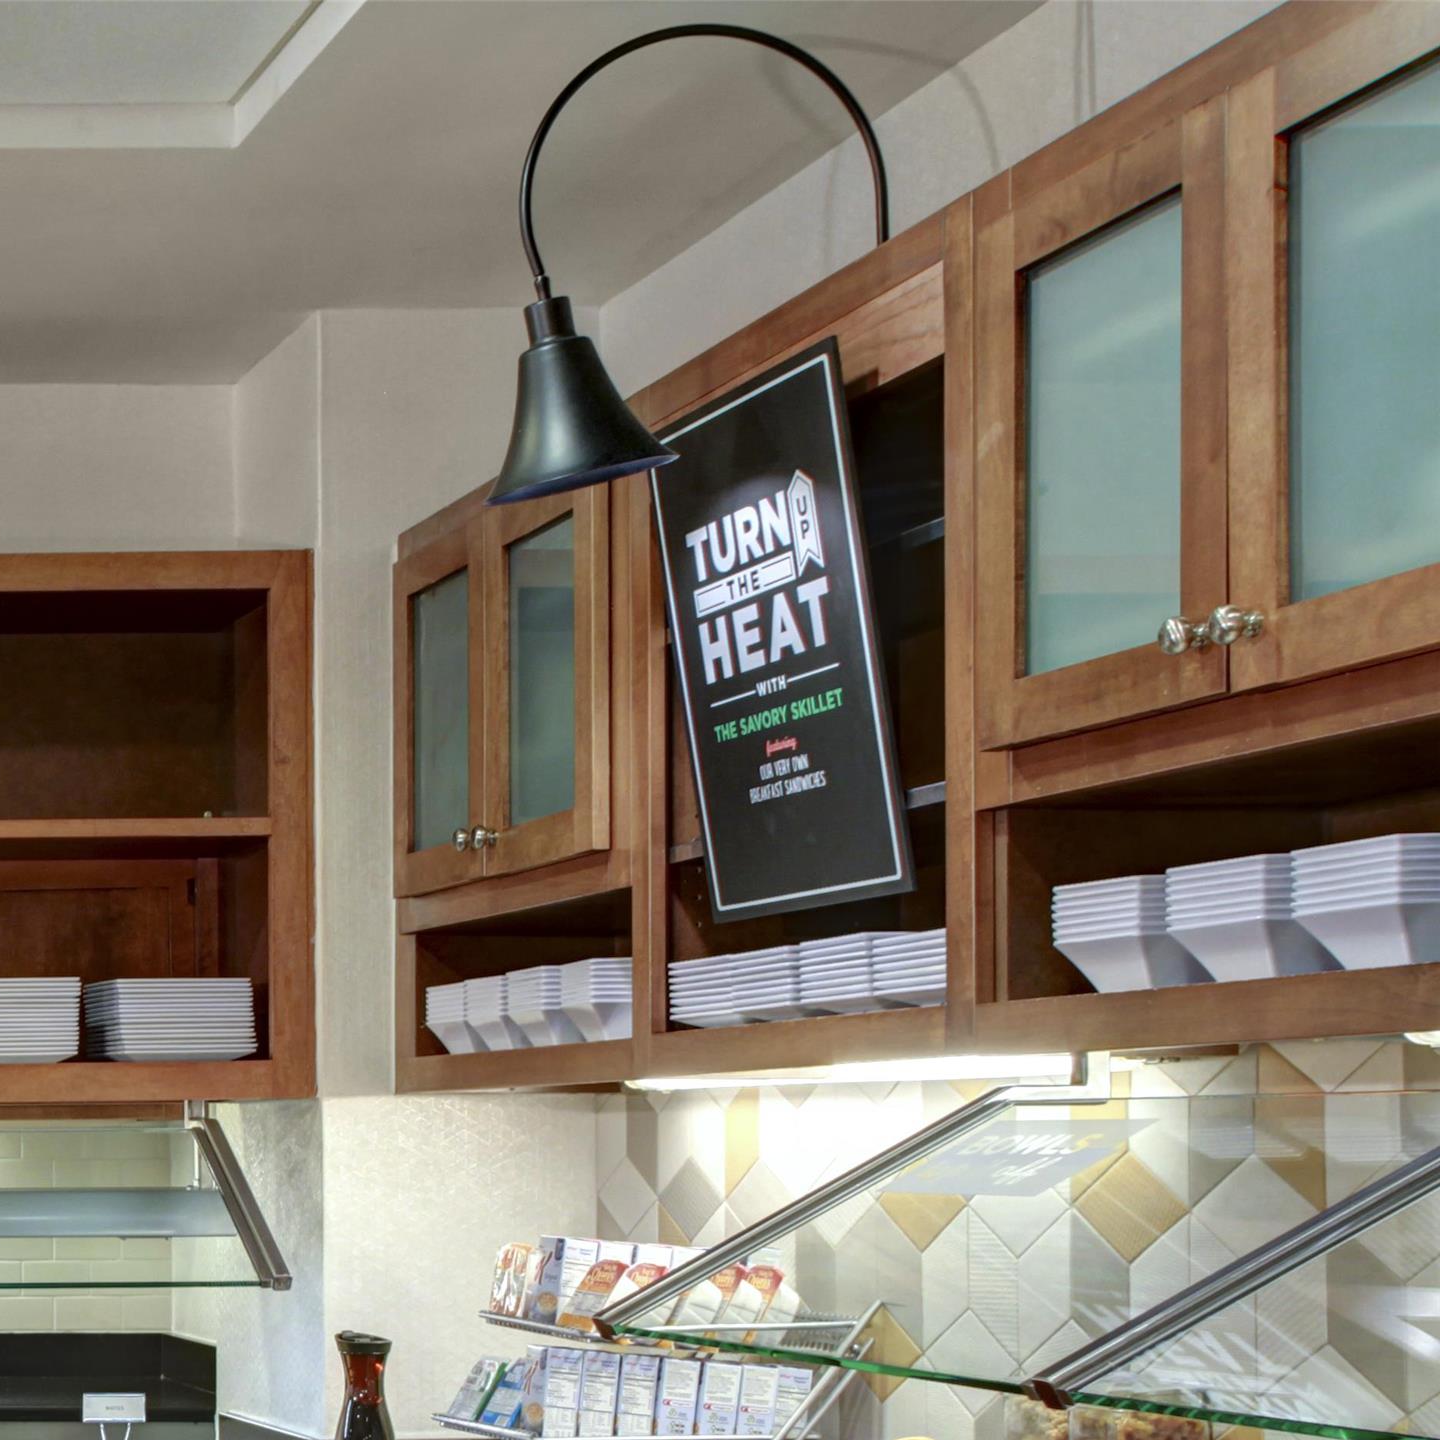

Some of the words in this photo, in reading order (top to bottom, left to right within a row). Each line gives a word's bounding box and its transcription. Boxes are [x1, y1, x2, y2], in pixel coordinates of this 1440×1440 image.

[685, 490, 792, 582] TURN
[795, 495, 810, 540] UP
[726, 569, 763, 600] THE
[698, 576, 830, 685] HEAT
[755, 674, 788, 698] WITH
[713, 720, 739, 743] THE
[739, 704, 788, 737] SAVORY
[790, 687, 843, 721] SKILLET
[957, 1133, 1105, 1155] BOWLS
